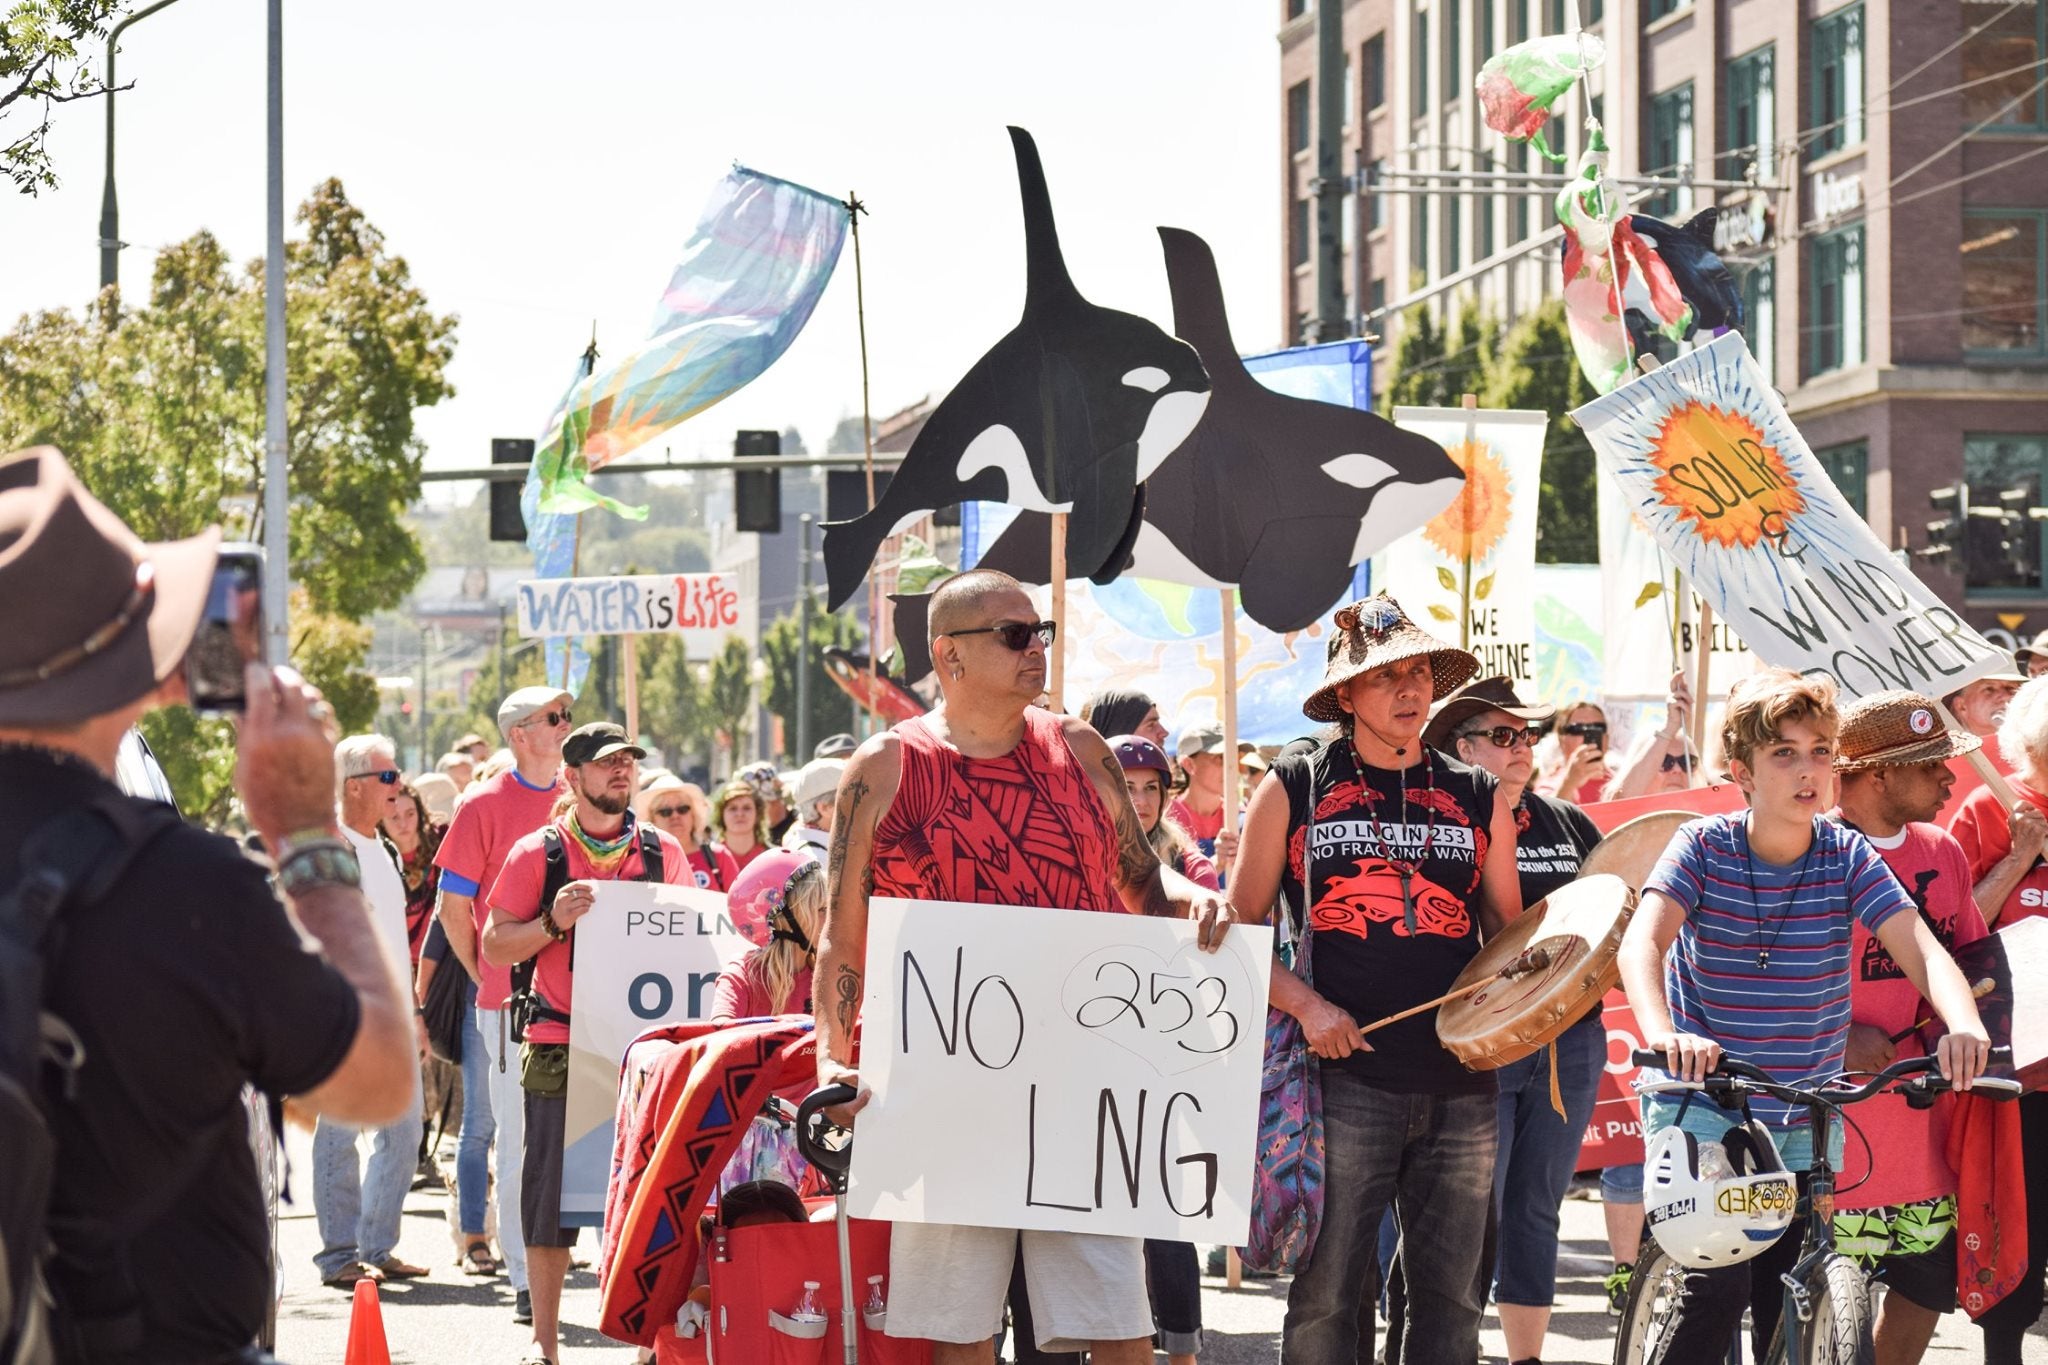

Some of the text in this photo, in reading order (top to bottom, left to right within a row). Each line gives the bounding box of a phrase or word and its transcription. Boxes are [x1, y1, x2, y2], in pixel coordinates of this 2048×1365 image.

[520, 575, 739, 633] WATER is Life
[1748, 559, 1910, 652] WIND
[1470, 608, 1499, 637] WE
[1472, 643, 1532, 681] SHINE
[1315, 823, 1466, 844] NO LNG IN 253
[1312, 842, 1476, 865] NO FRACKING WAY!
[1537, 845, 1557, 858] the
[626, 911, 686, 937] PSE
[901, 945, 1239, 1070] NO 253
[1026, 1083, 1219, 1219] LNG
